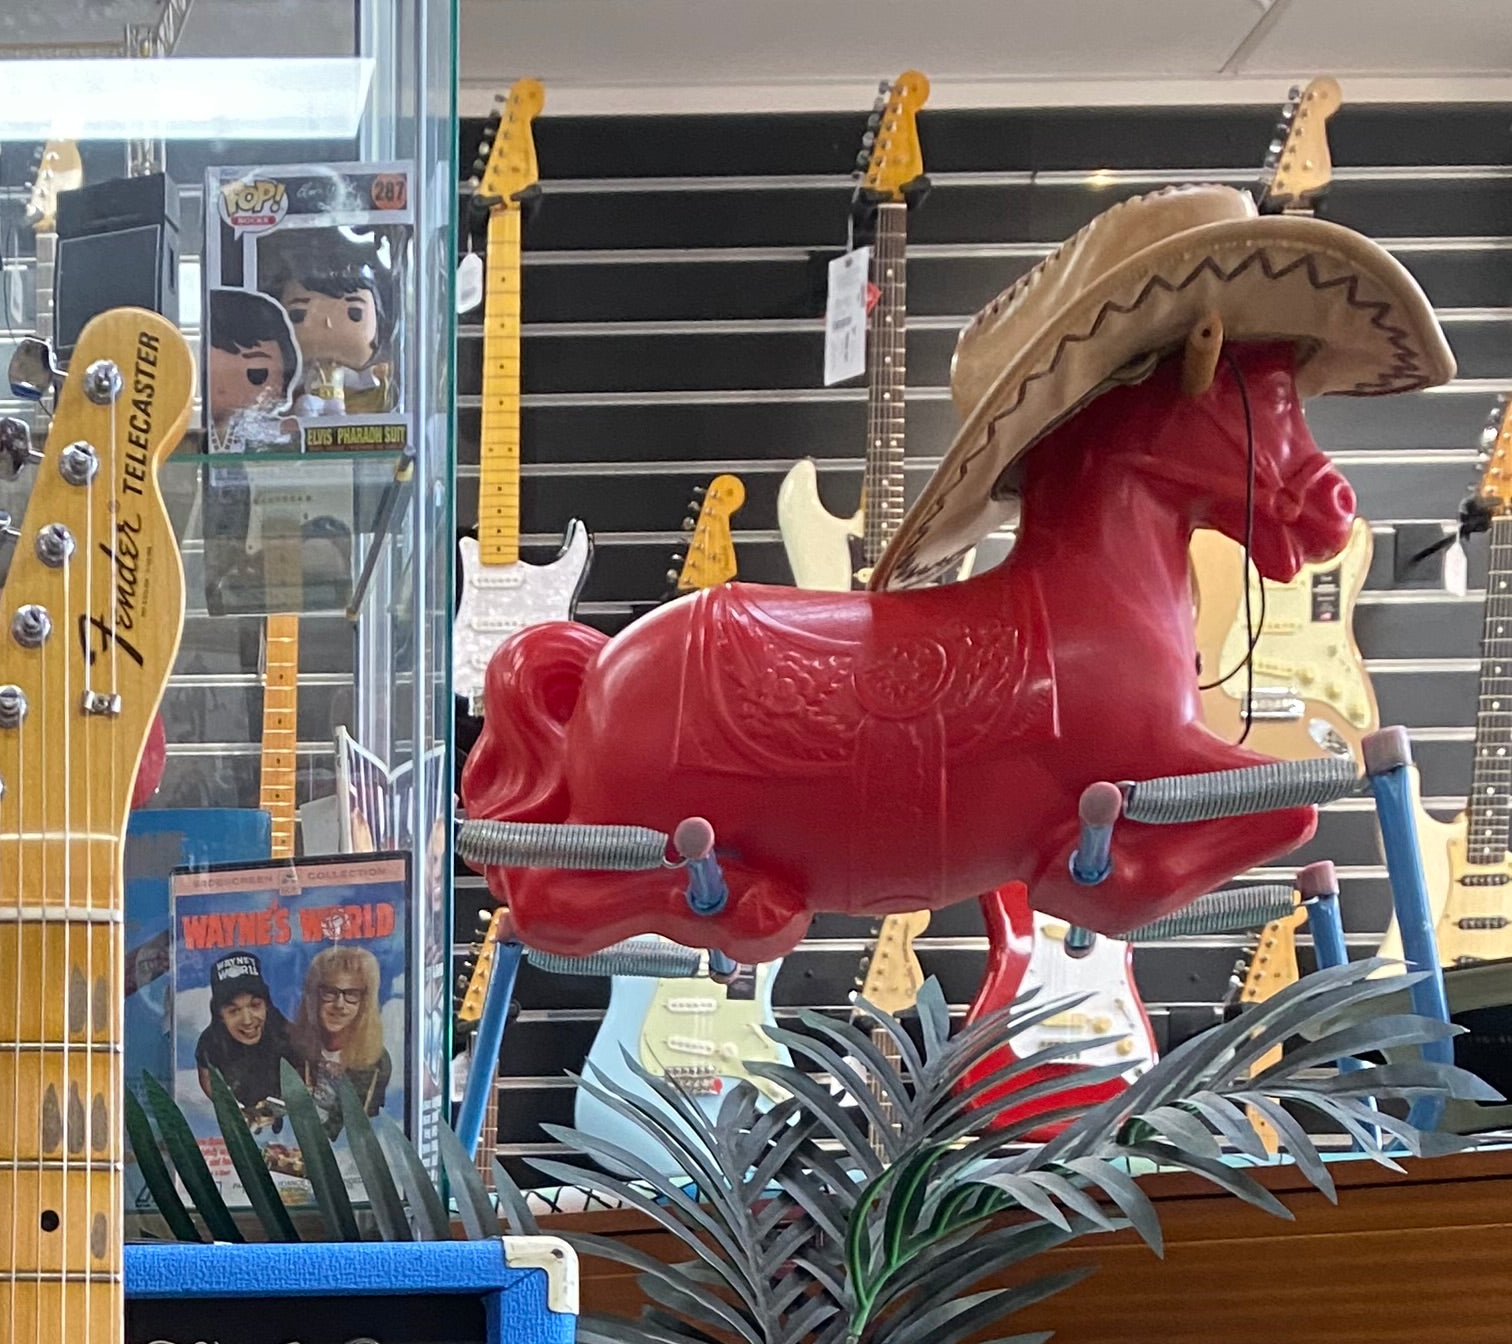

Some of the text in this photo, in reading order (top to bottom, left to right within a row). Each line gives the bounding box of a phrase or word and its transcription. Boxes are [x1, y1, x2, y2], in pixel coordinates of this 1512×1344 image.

[221, 179, 287, 217] POP!
[308, 428, 333, 445] ELVIS
[384, 425, 405, 443] SUIT
[79, 331, 161, 668] Fender TELECASTER
[182, 899, 396, 950] WAYNE'S WORLD
